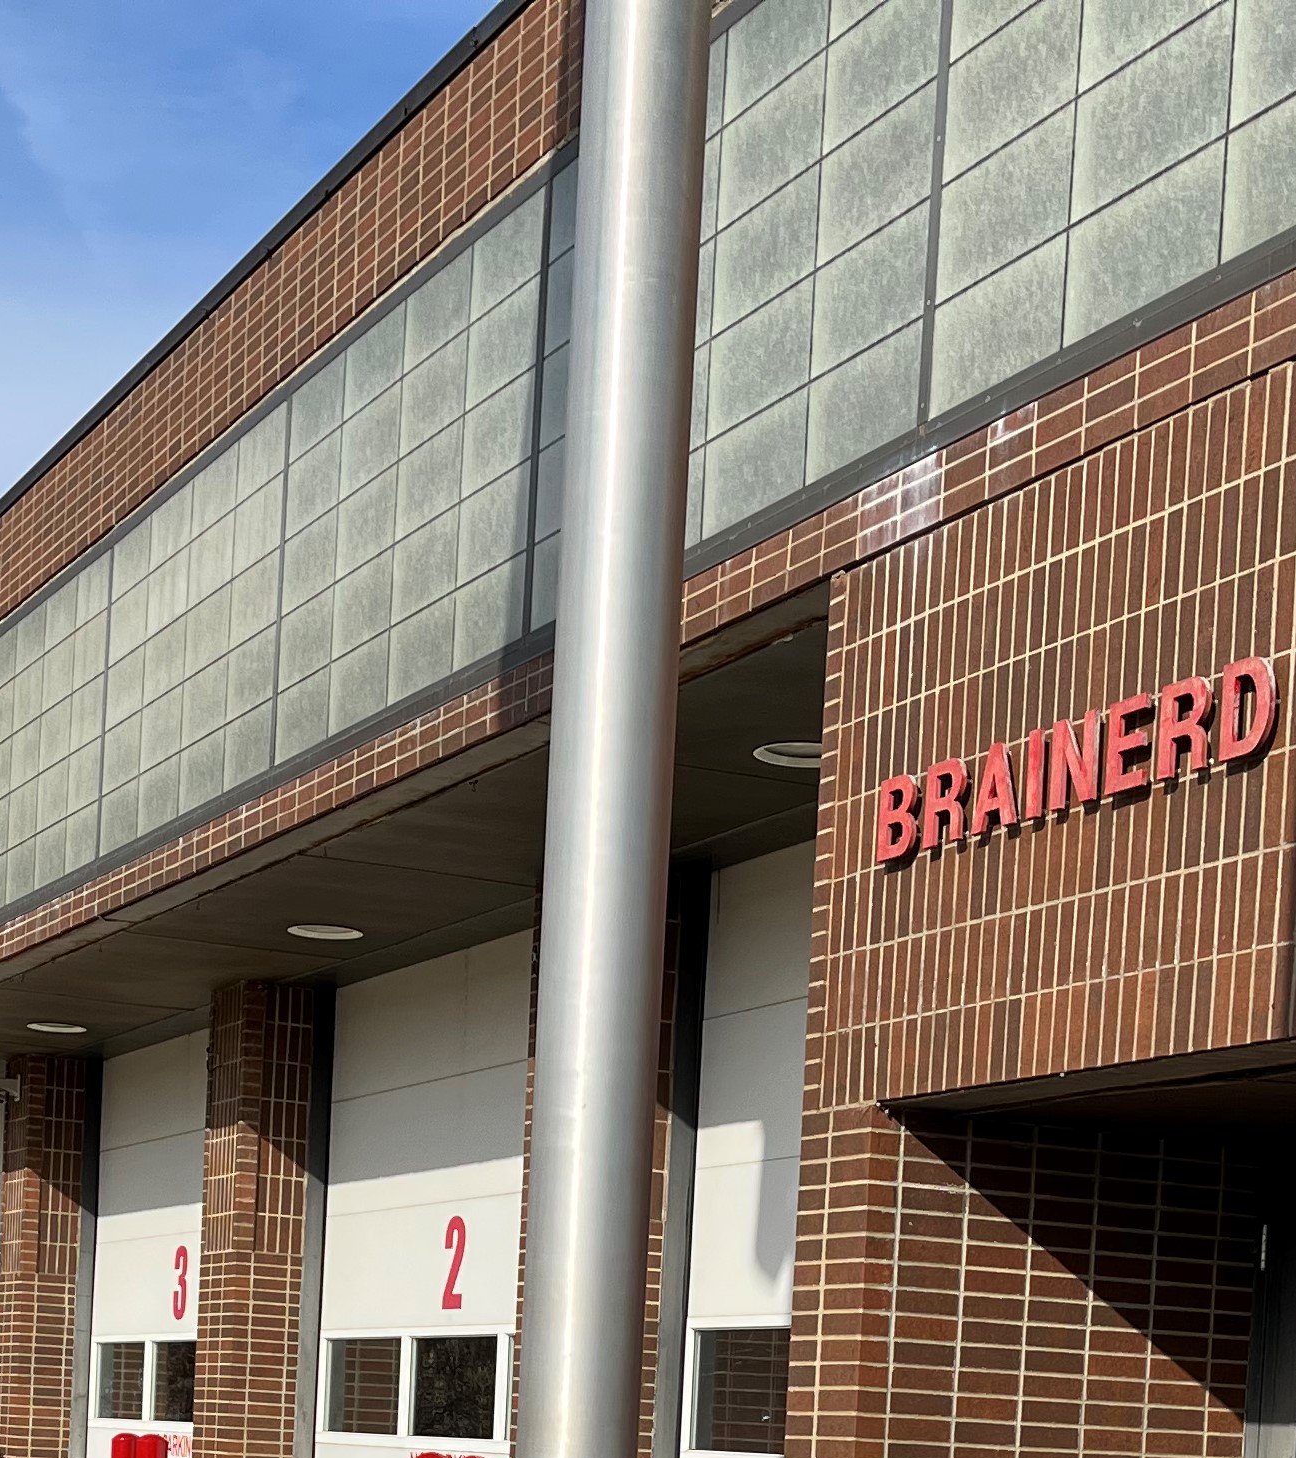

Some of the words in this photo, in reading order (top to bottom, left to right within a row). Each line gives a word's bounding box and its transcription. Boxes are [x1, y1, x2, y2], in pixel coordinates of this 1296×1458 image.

[876, 655, 1277, 864] BRAINERD
[172, 1245, 188, 1321] 3
[441, 1215, 466, 1310] 2
